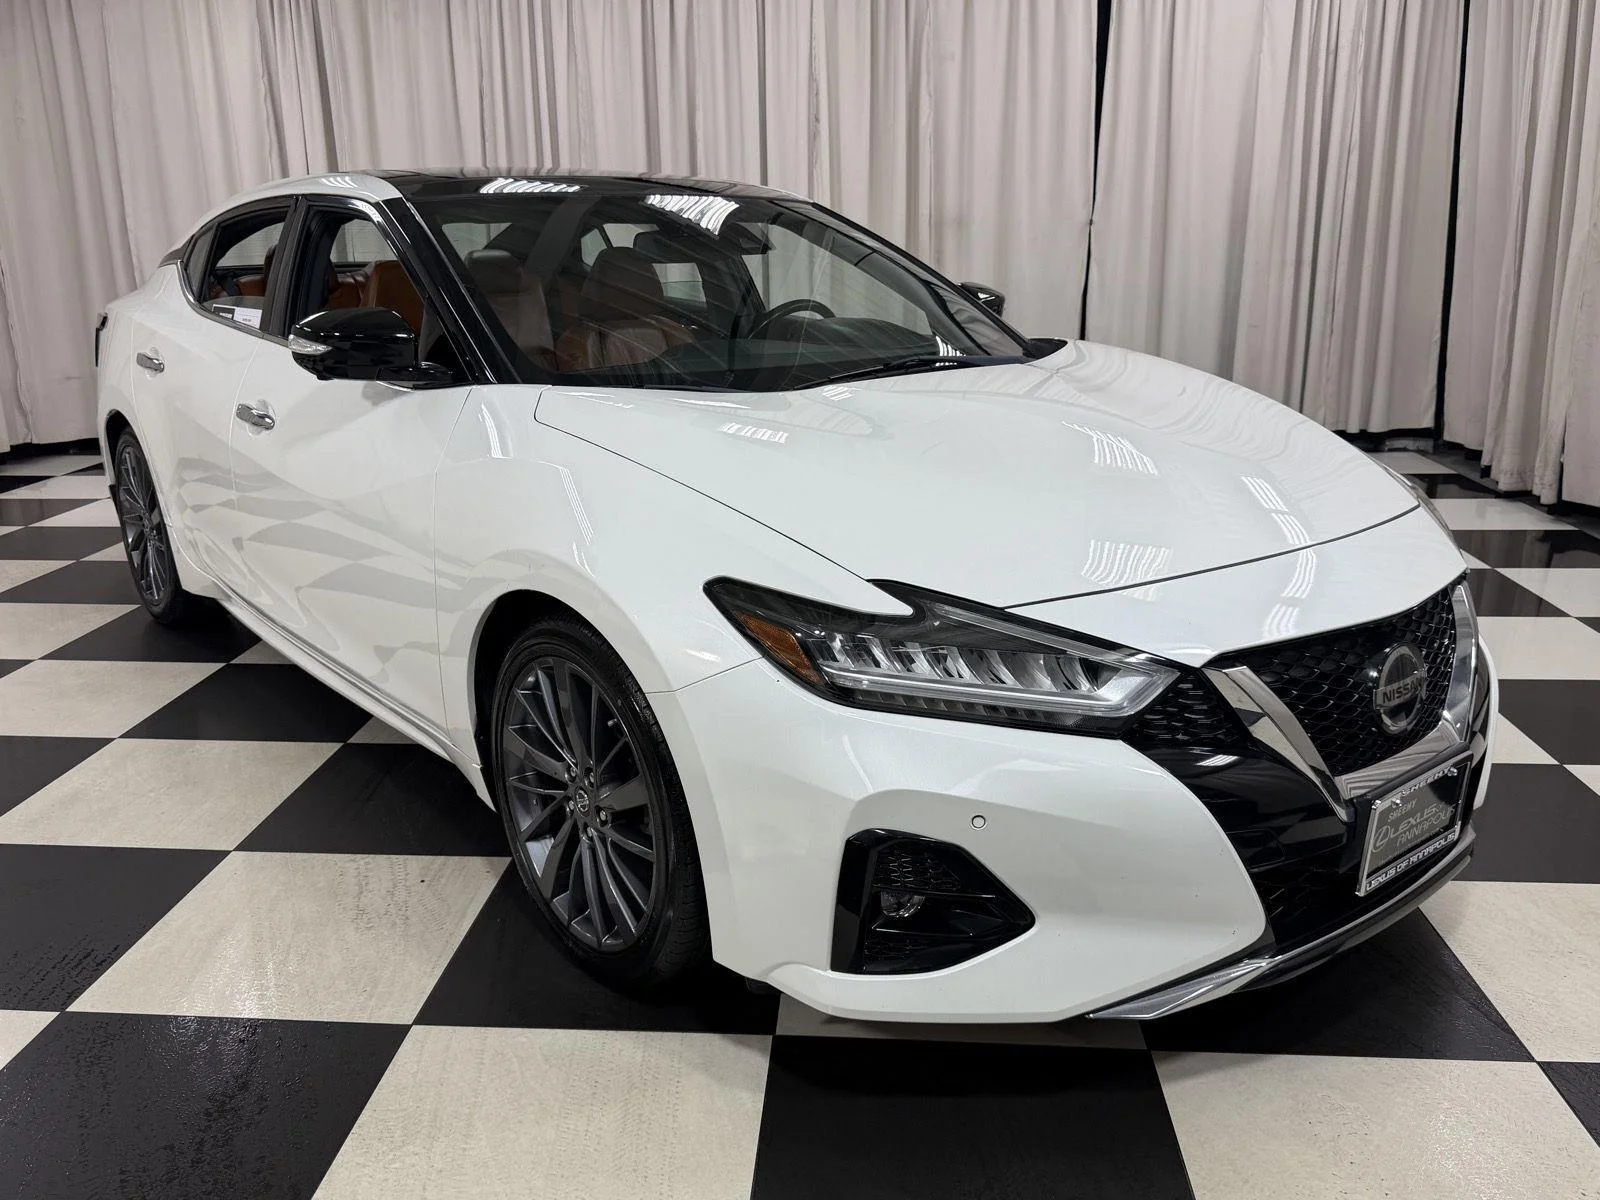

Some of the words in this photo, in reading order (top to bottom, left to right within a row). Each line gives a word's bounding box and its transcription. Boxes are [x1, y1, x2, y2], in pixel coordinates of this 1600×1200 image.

[1382, 677, 1423, 704] NISSAN
[1390, 803, 1439, 838] LEXUS
[1366, 867, 1396, 891] LEXUS
[1396, 859, 1409, 872] OF
[1409, 832, 1456, 865] ANNAPOLIS
